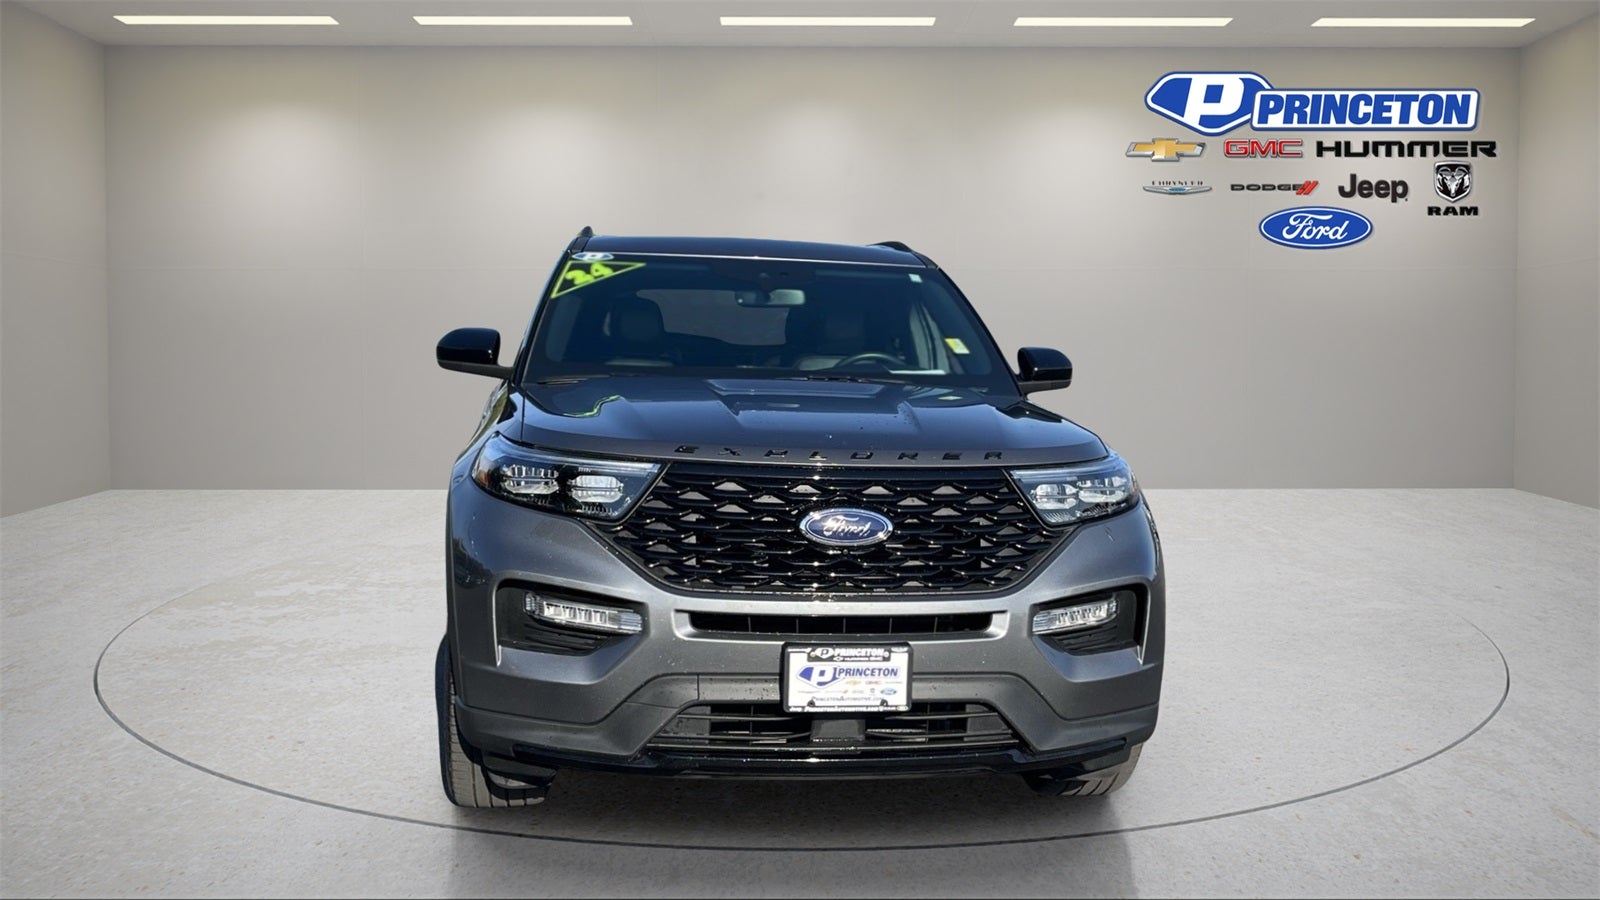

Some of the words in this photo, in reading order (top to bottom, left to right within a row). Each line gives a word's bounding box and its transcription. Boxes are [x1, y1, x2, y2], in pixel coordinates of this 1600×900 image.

[674, 444, 1003, 461] EXPLORER
[821, 515, 871, 537] Ford
[838, 668, 898, 678] PRINCETON
